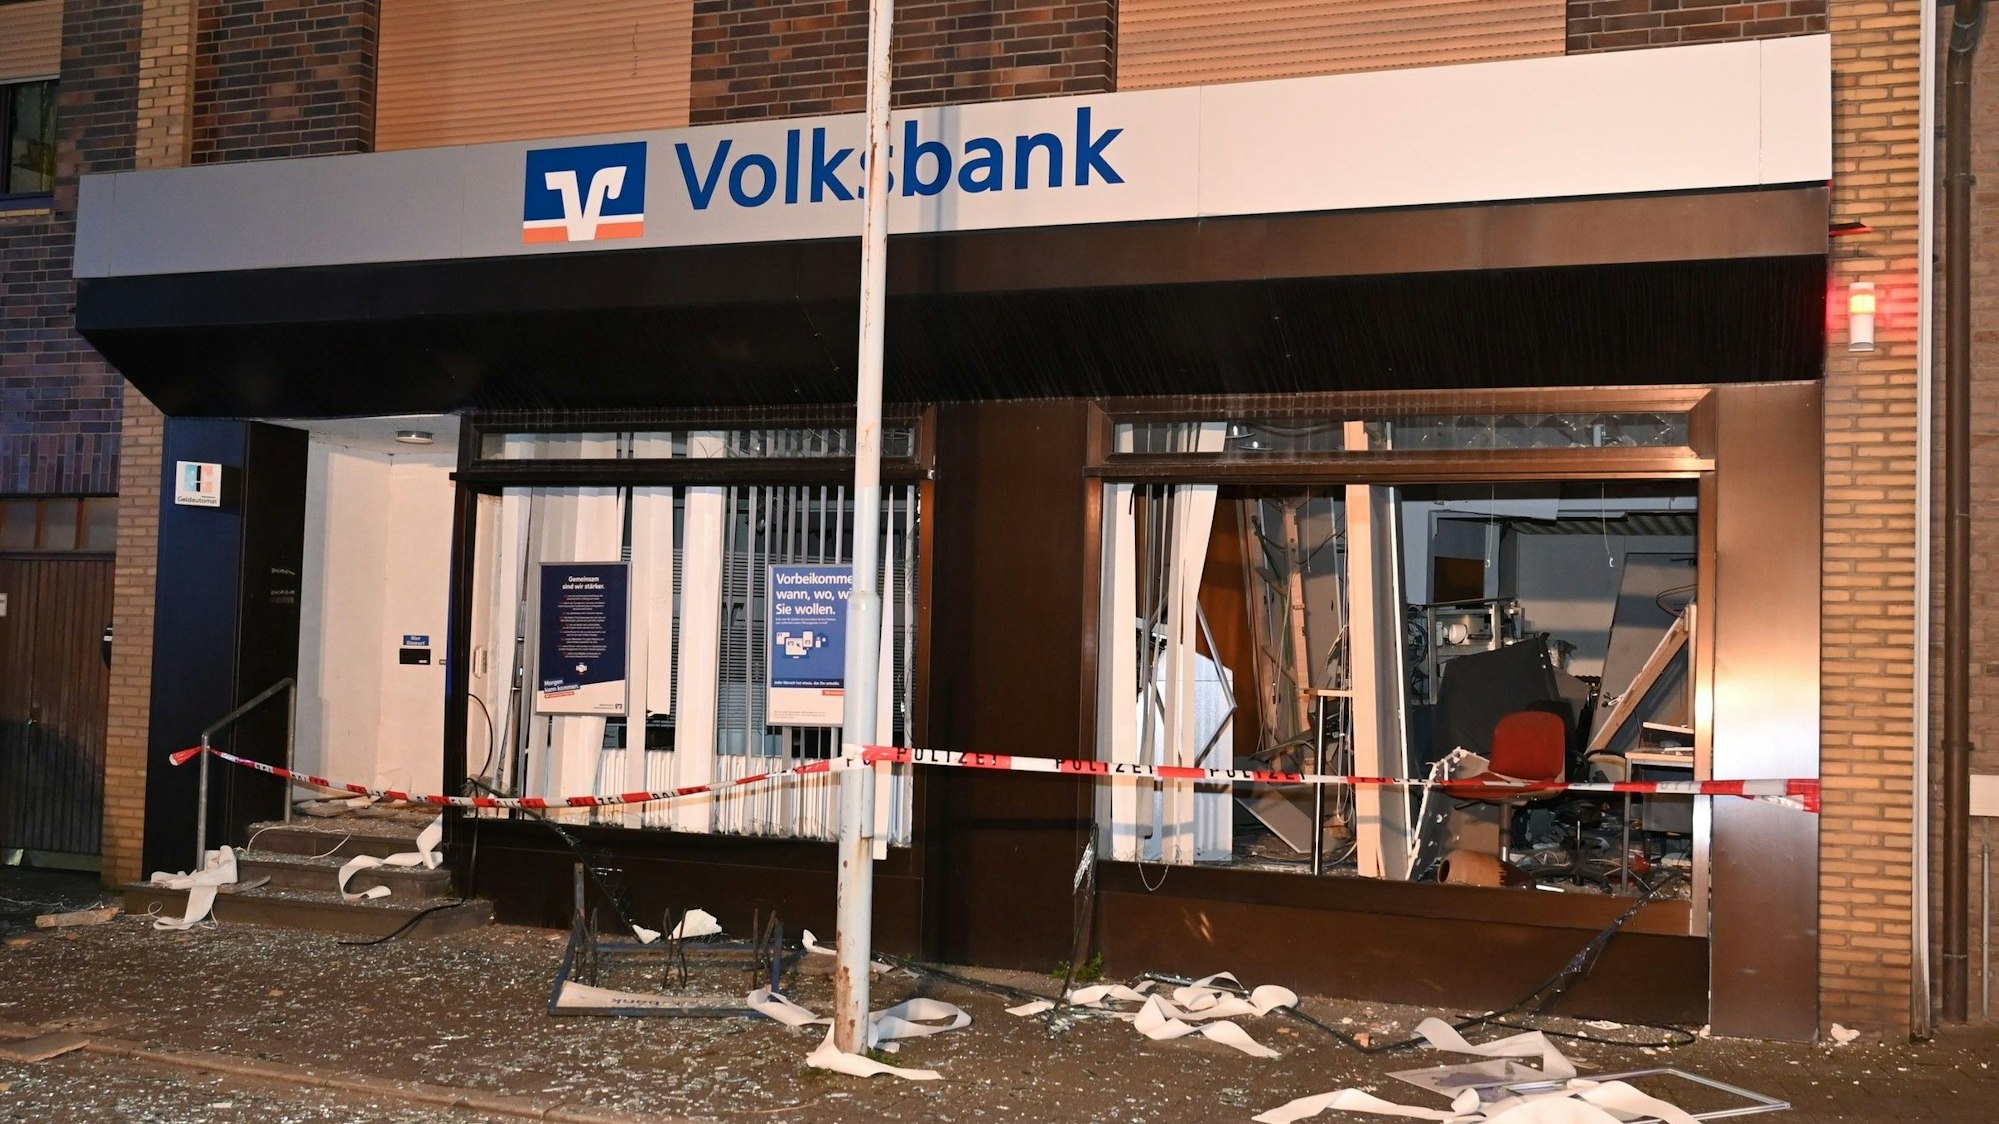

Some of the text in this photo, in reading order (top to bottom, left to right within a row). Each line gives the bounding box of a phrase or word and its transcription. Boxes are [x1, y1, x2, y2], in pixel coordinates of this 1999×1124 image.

[177, 496, 217, 504] Geldautomat
[776, 572, 853, 585] Vorbeikomme
[776, 590, 811, 601] wann,
[813, 590, 835, 601] wo,
[775, 603, 836, 615] Sie wollen.
[897, 748, 997, 765] POLIZEI
[1055, 759, 1153, 774] POLIZEI
